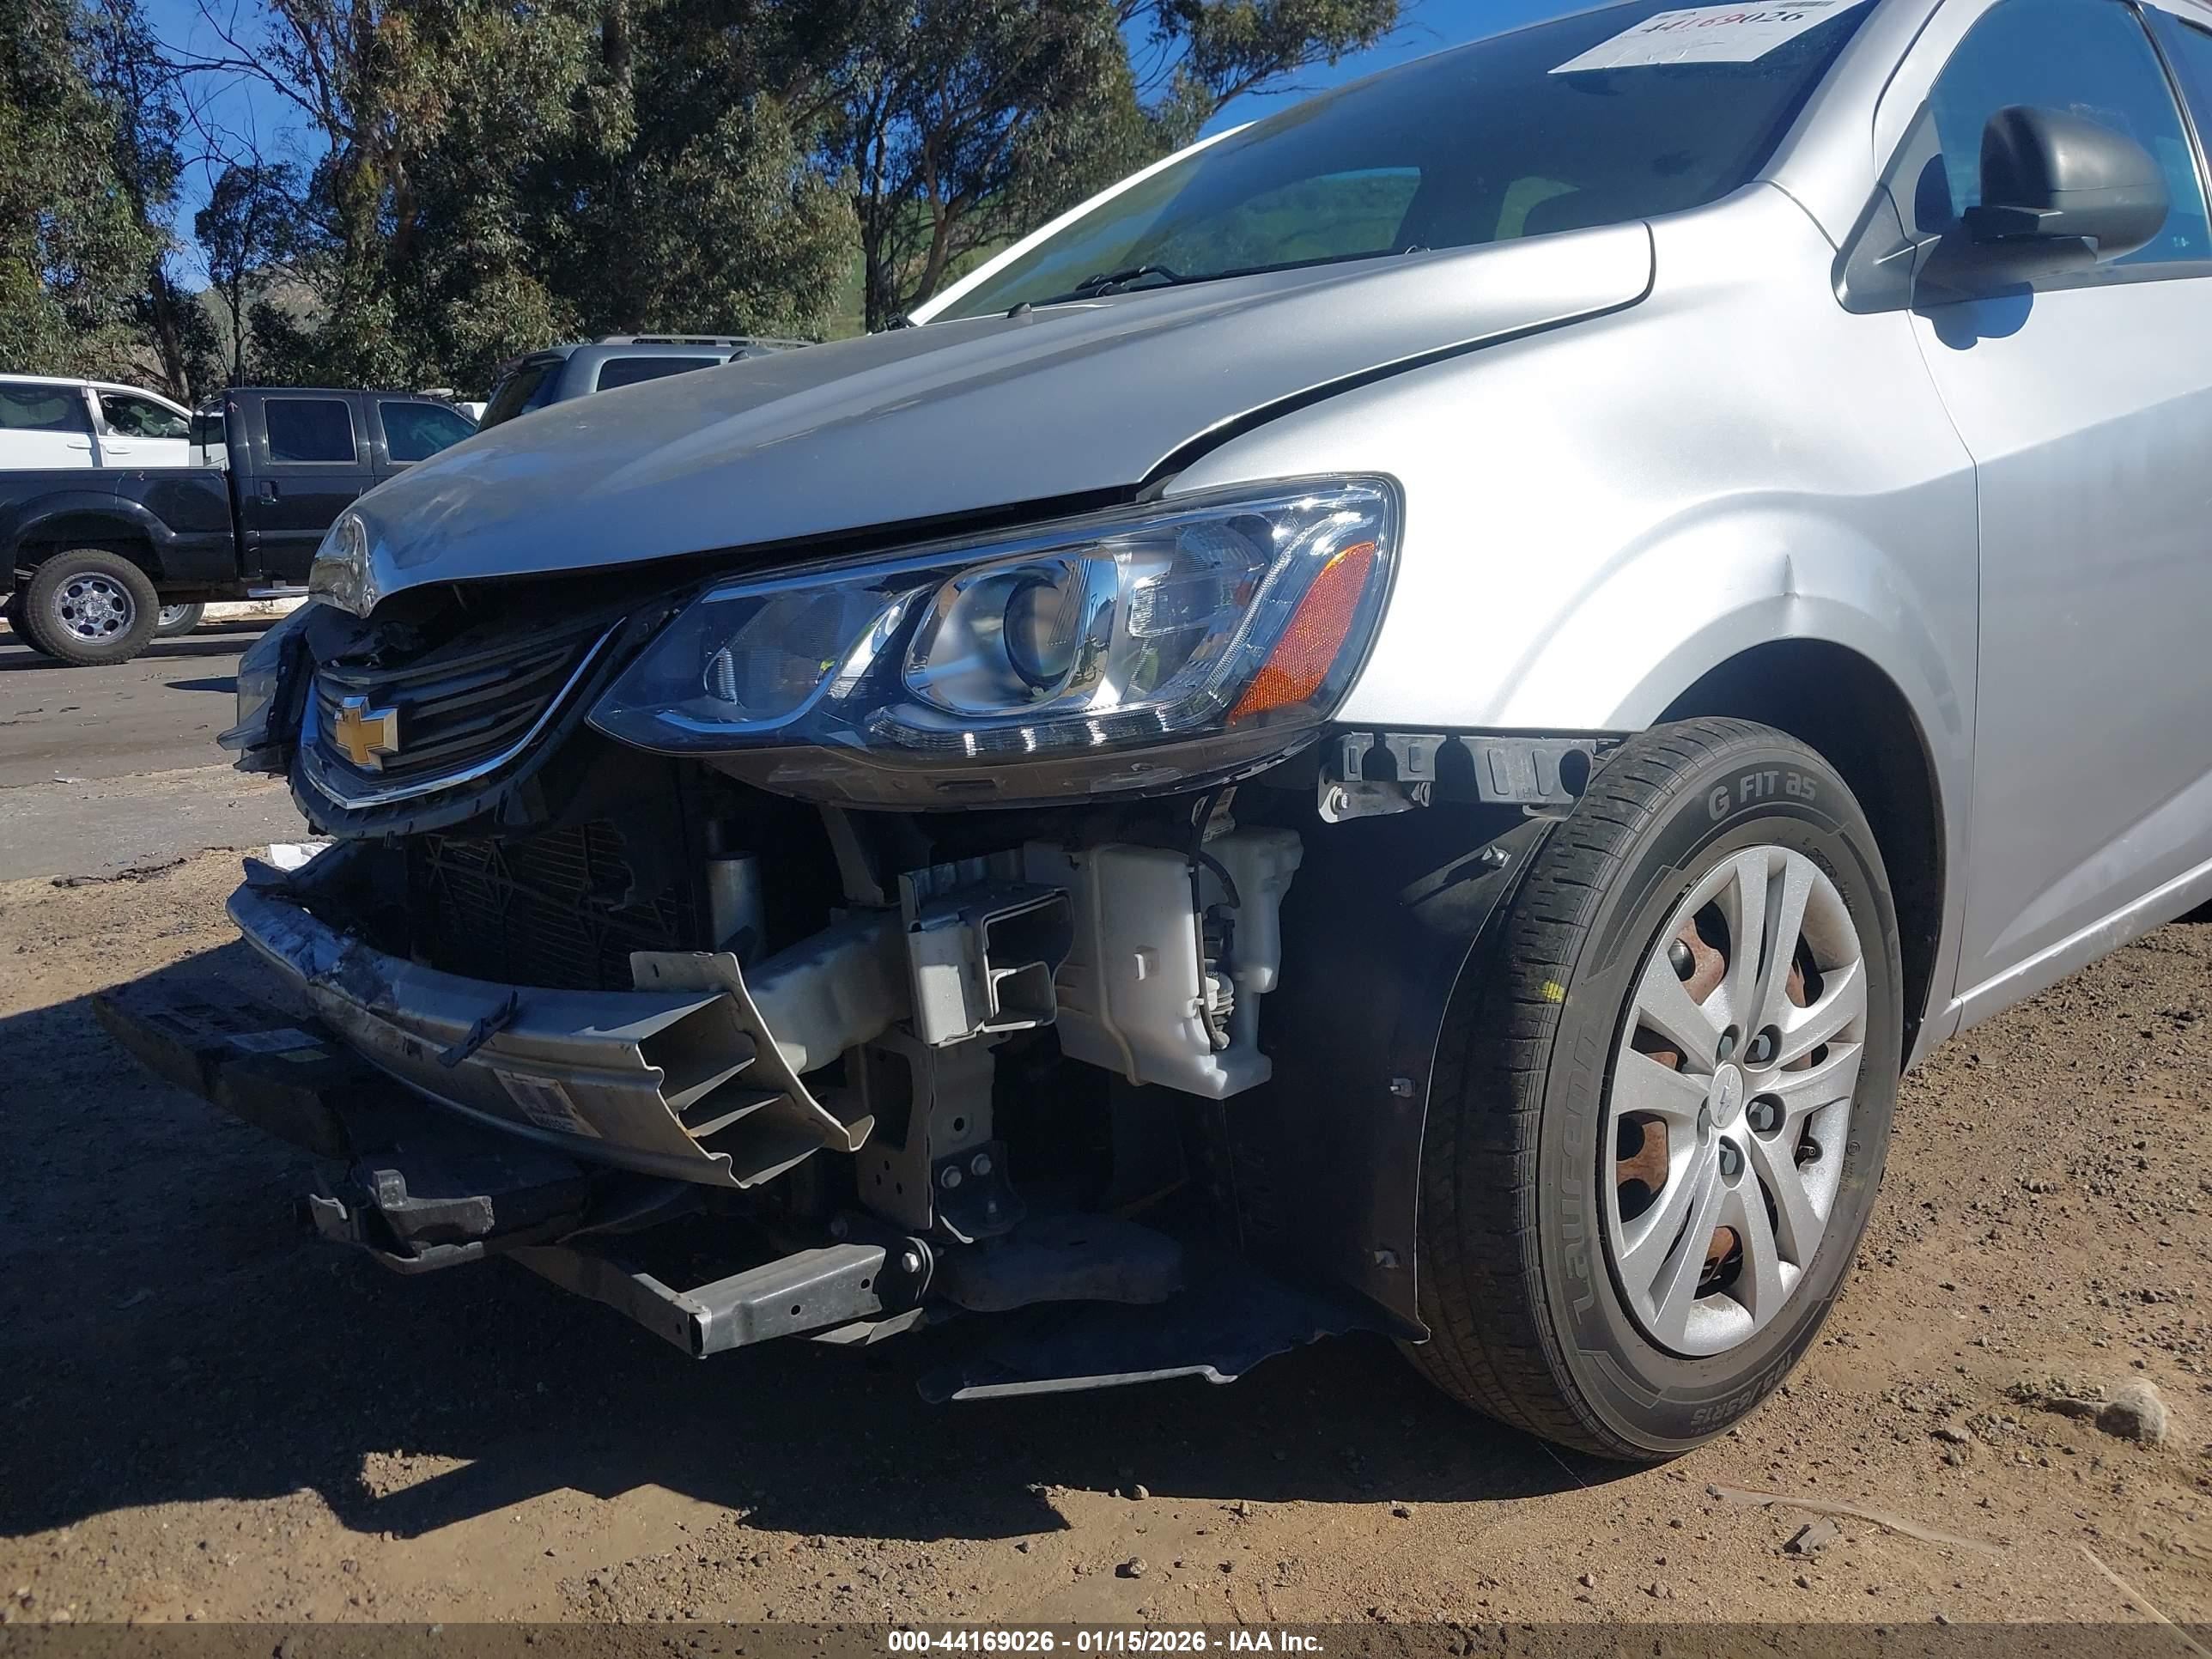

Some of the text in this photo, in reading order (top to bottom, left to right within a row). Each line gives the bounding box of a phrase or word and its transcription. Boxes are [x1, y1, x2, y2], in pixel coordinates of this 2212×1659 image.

[1641, 10, 1805, 33] 44169026
[1708, 785, 1731, 821] G
[1740, 770, 1779, 804] FIT
